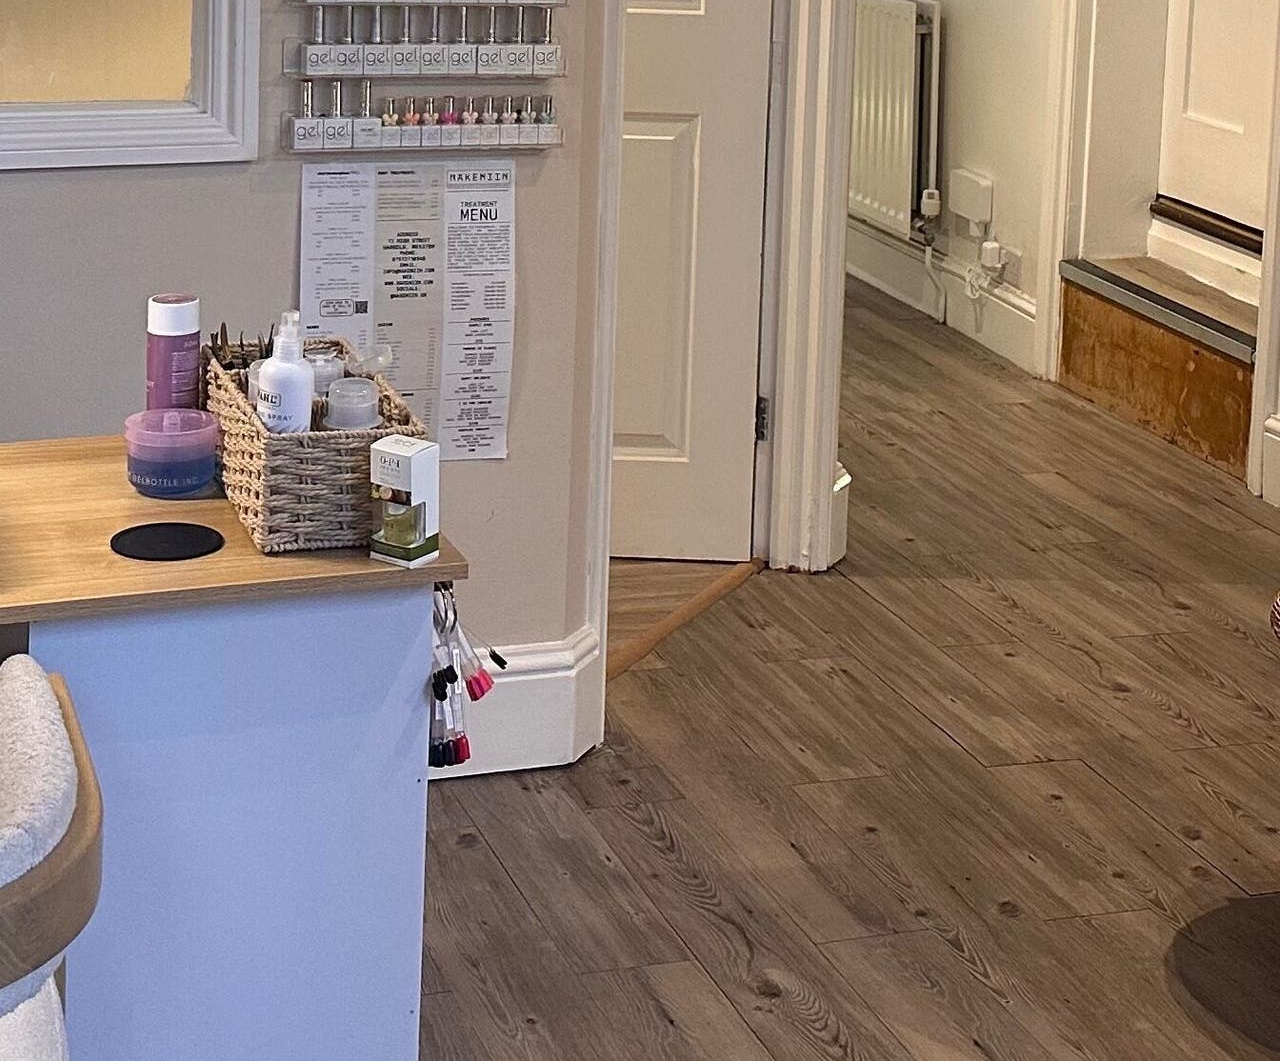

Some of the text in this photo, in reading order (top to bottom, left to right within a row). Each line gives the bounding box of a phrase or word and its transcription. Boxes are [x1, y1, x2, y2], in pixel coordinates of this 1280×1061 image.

[309, 48, 333, 66] gel
[337, 48, 362, 66] gel
[366, 48, 391, 66] gel
[394, 48, 418, 65] gel
[422, 48, 447, 65] gel
[452, 48, 475, 65] gel
[480, 48, 503, 65] gel
[507, 48, 531, 65] gel
[536, 48, 559, 65] gel
[296, 122, 321, 140] gel
[326, 122, 350, 140] gel
[460, 208, 498, 221] MENU
